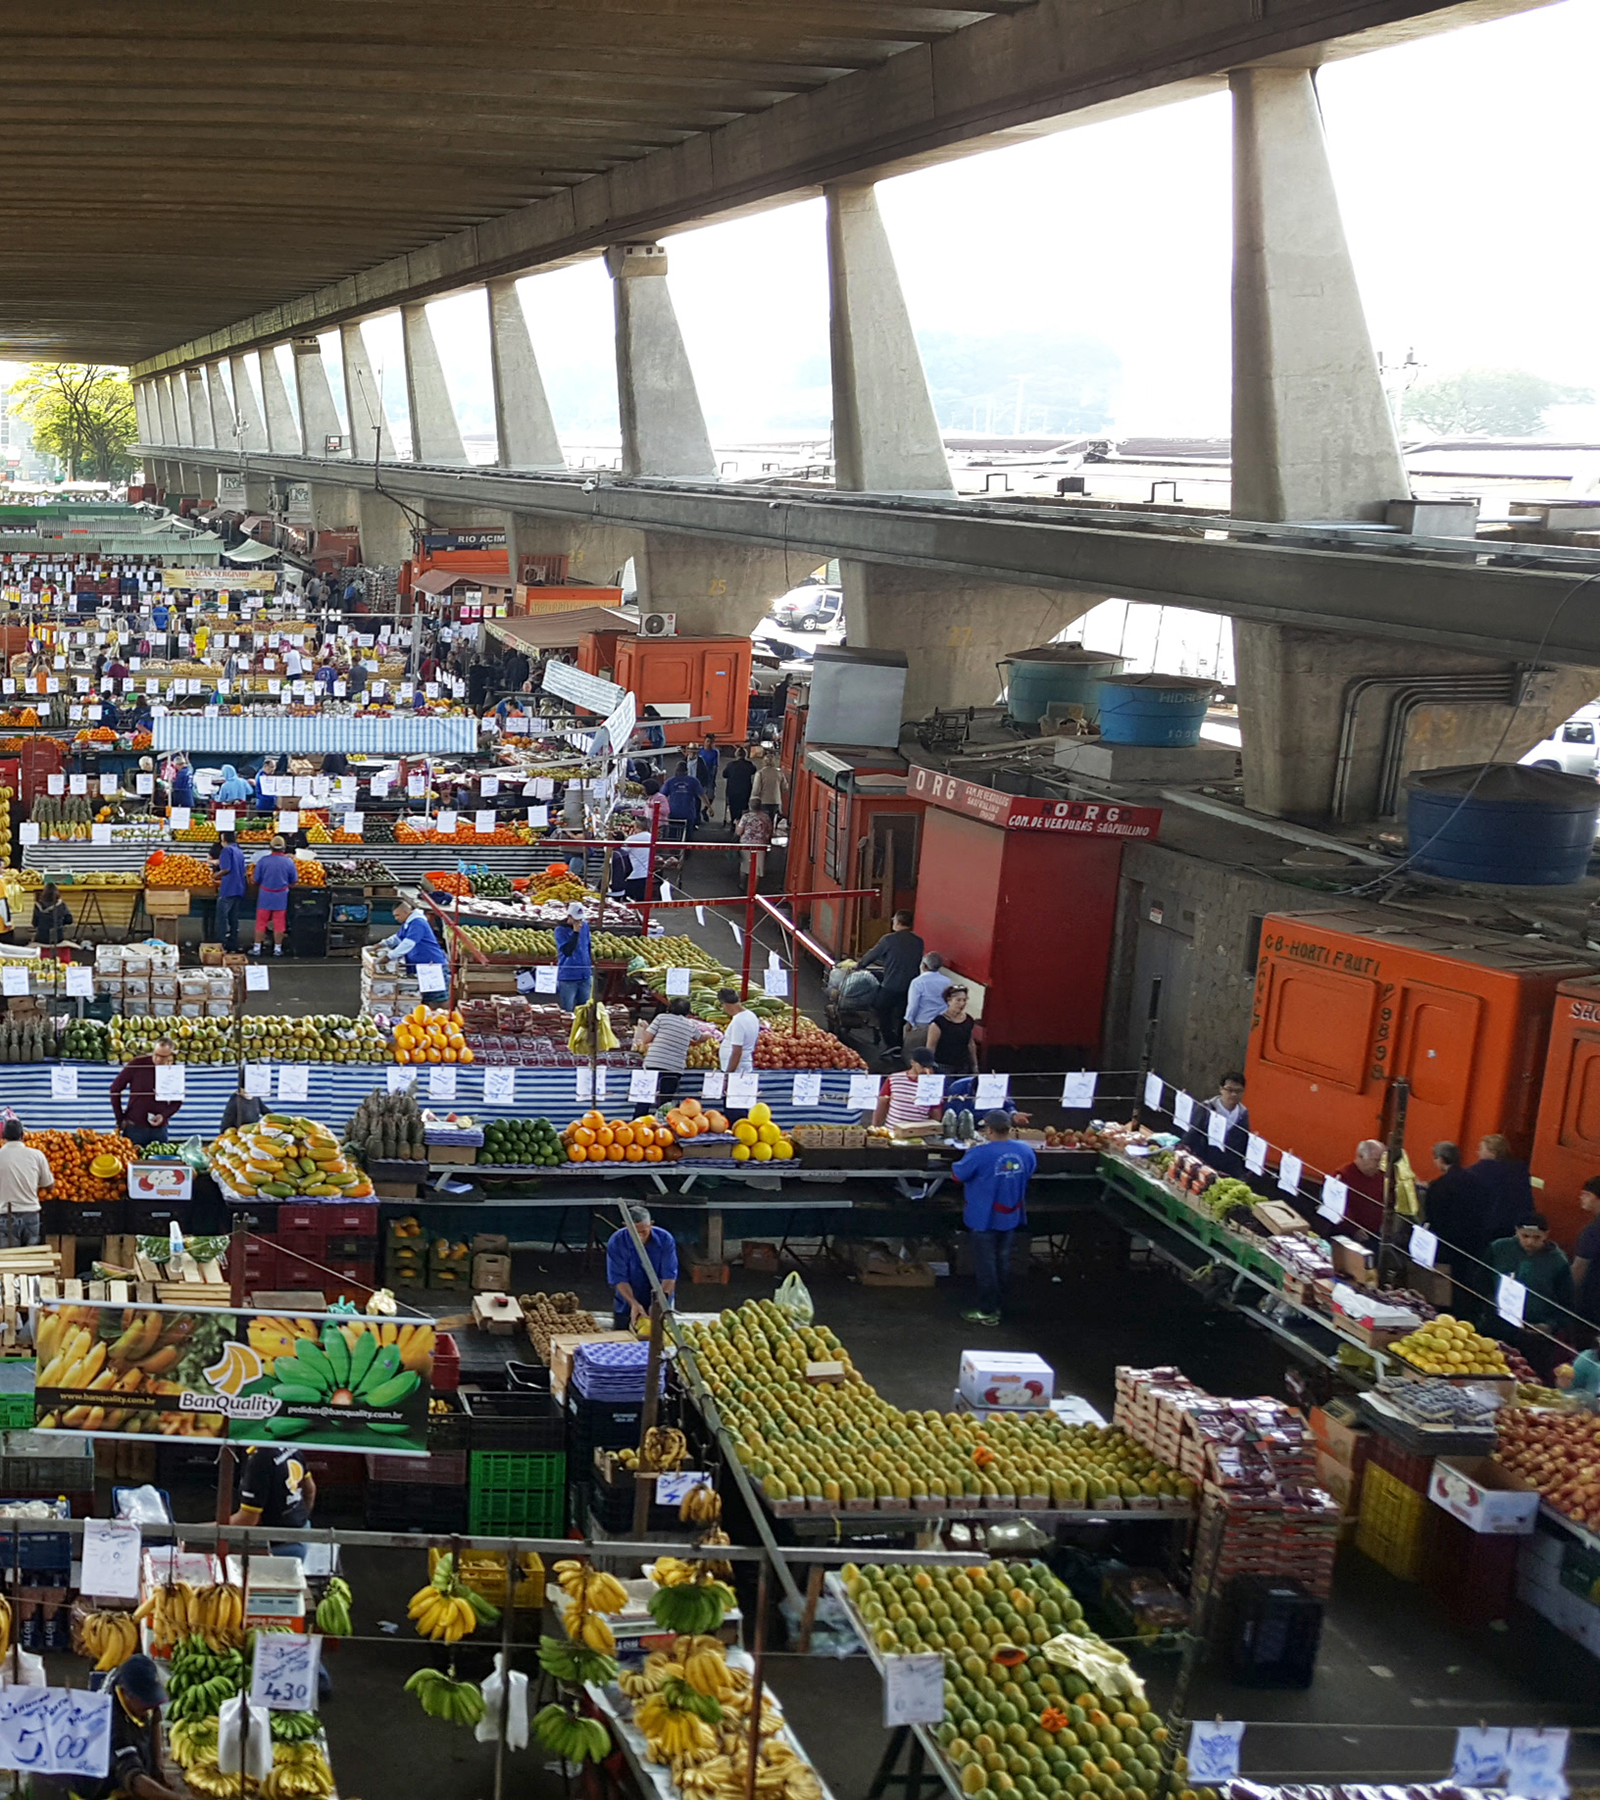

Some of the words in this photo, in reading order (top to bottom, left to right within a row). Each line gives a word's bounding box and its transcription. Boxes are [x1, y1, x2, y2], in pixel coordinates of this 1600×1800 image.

[458, 535, 476, 543] RIO
[568, 550, 584, 563] 23
[708, 579, 727, 596] 25
[1045, 819, 1093, 832] VERDURAS
[1332, 950, 1382, 977] FRUTI
[60, 1391, 156, 1405] www.banquality.com.br
[182, 1393, 278, 1413] BanQuality
[288, 1406, 403, 1420] pedidos@banquality.com.br
